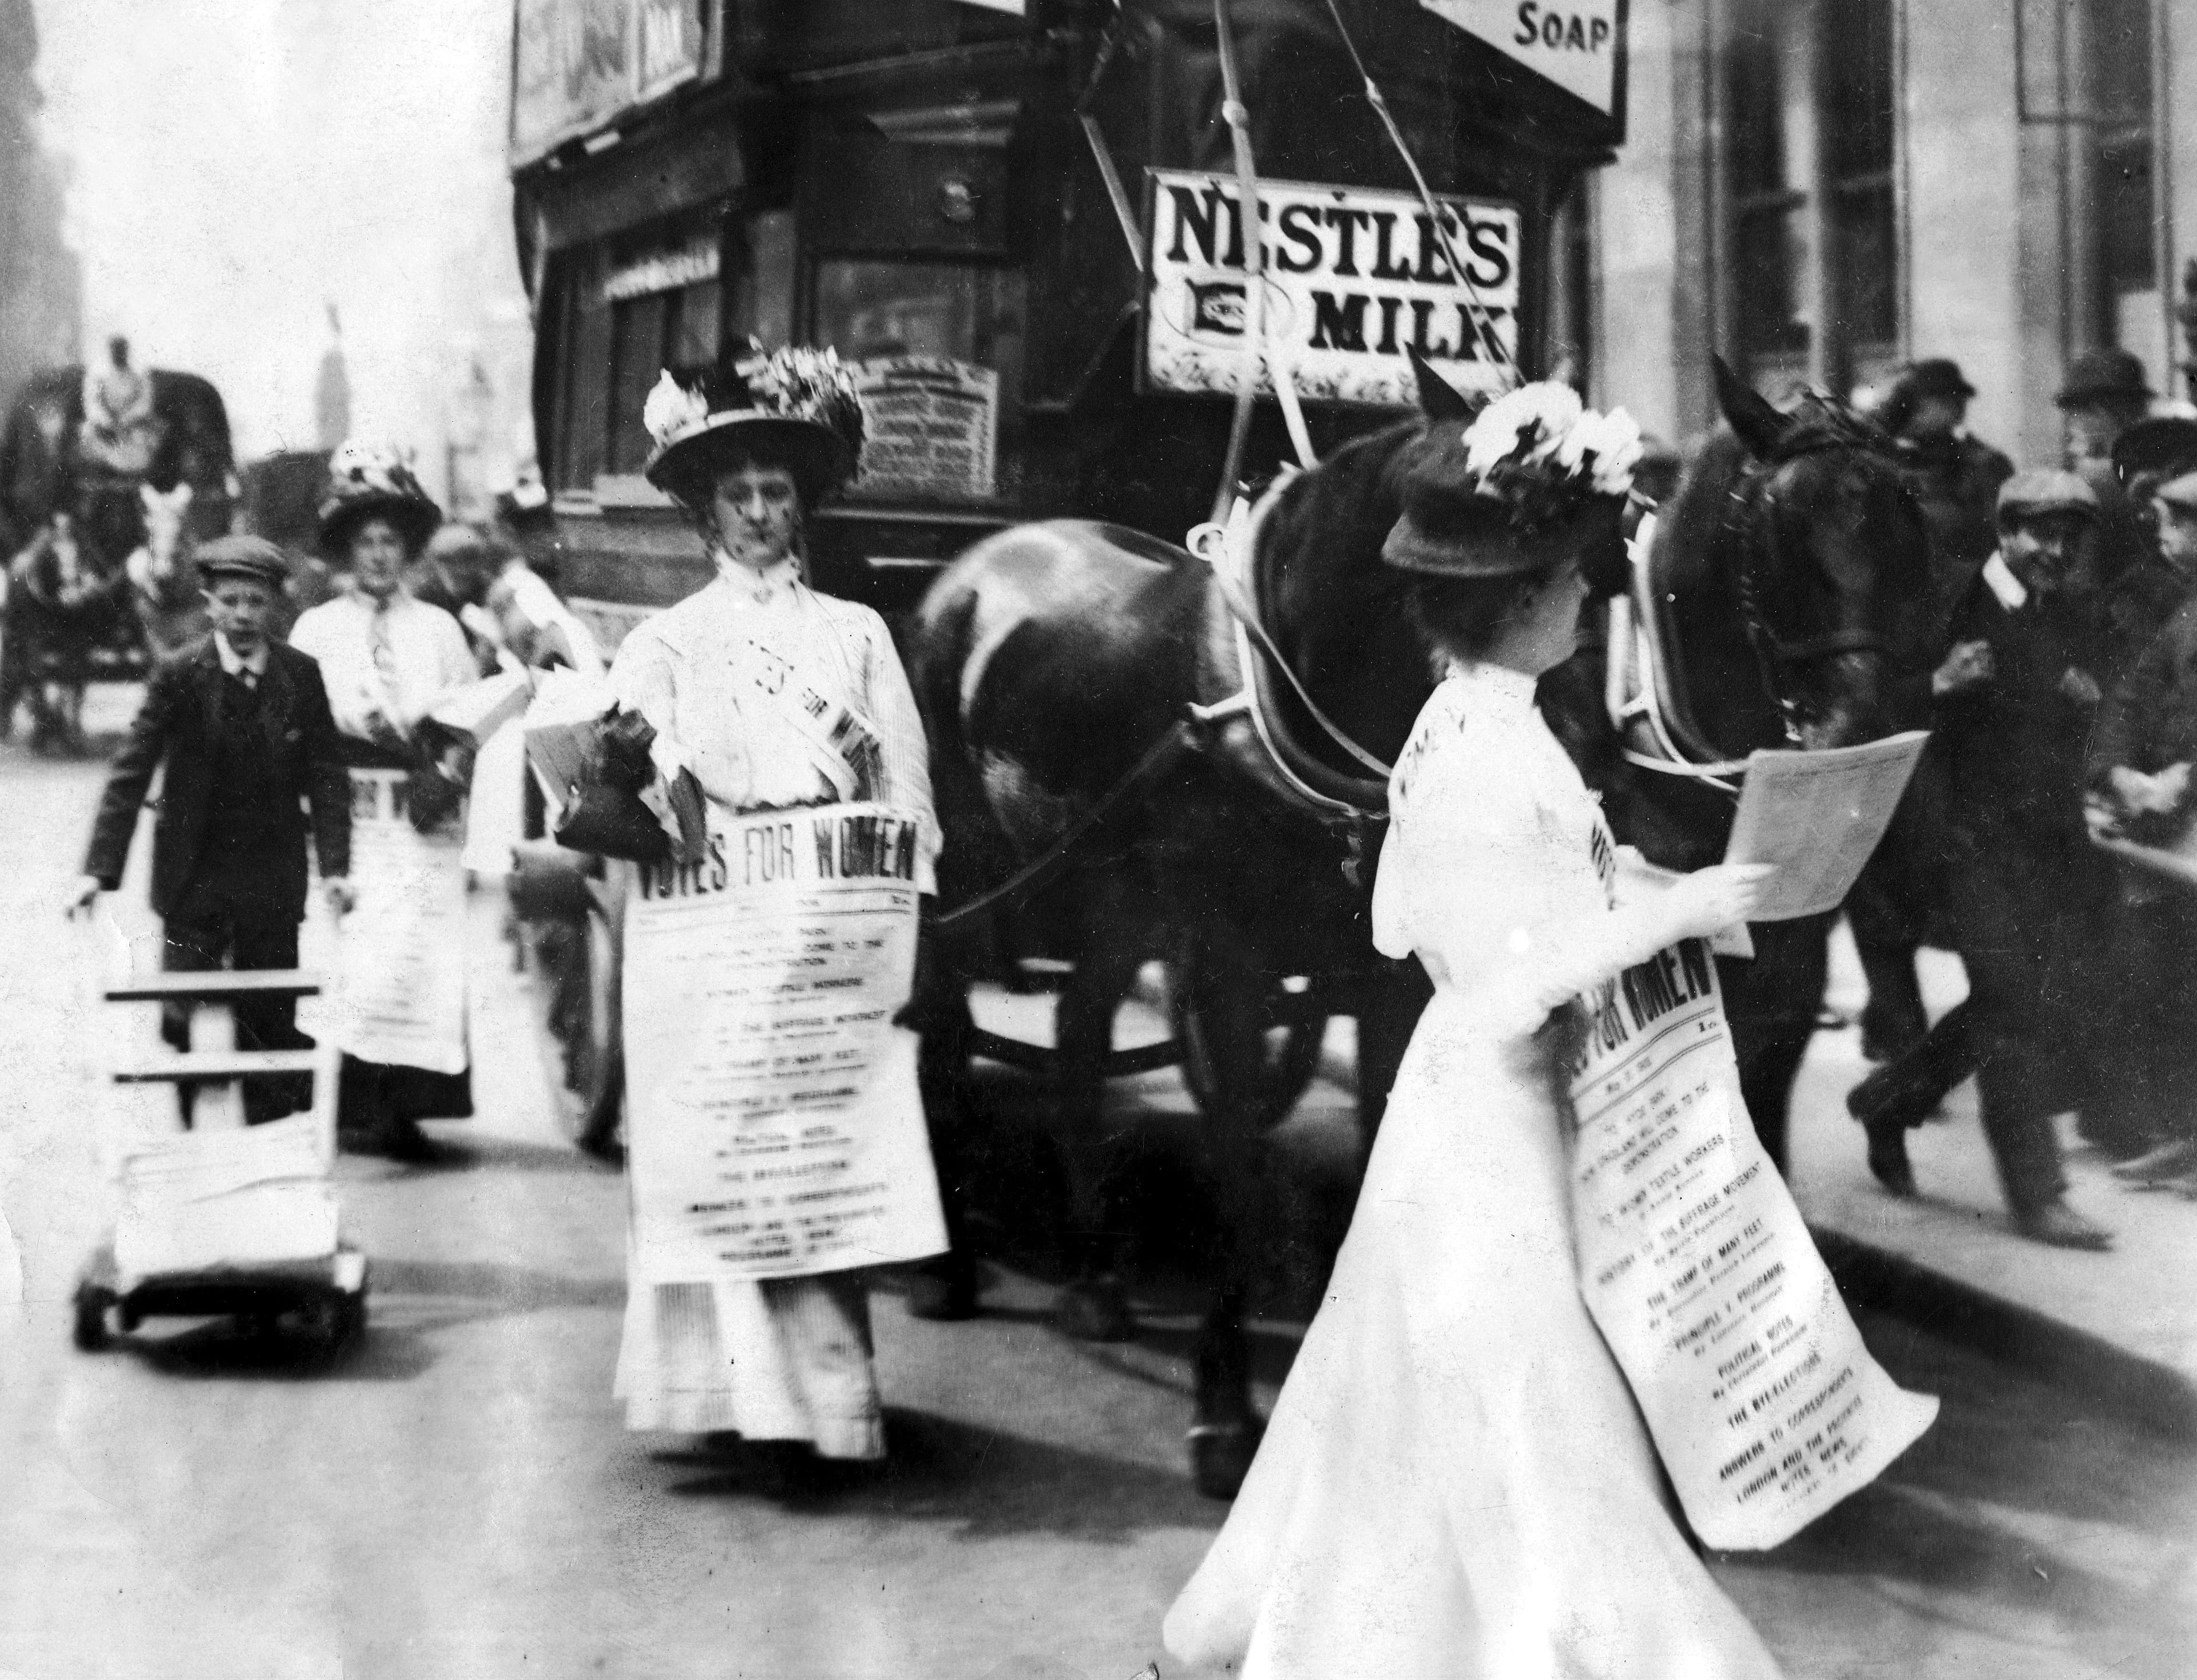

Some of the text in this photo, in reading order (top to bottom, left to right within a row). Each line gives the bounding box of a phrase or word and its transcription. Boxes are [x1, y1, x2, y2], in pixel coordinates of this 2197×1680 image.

[1514, 1, 1609, 52] SOAP
[1308, 290, 1508, 363] MILK
[745, 823, 794, 885] FOR
[812, 816, 917, 881] WOMEN
[1683, 1134, 1724, 1166] WORKERS
[1679, 1193, 1720, 1230] SUFFRAGE
[1722, 1161, 1759, 1196] MOVEMENT
[1718, 1237, 1740, 1258] MANY
[1743, 1217, 1762, 1239] FEET
[1737, 1262, 1786, 1303] PROGRAMME
[1717, 1341, 1761, 1379] POLITICAL
